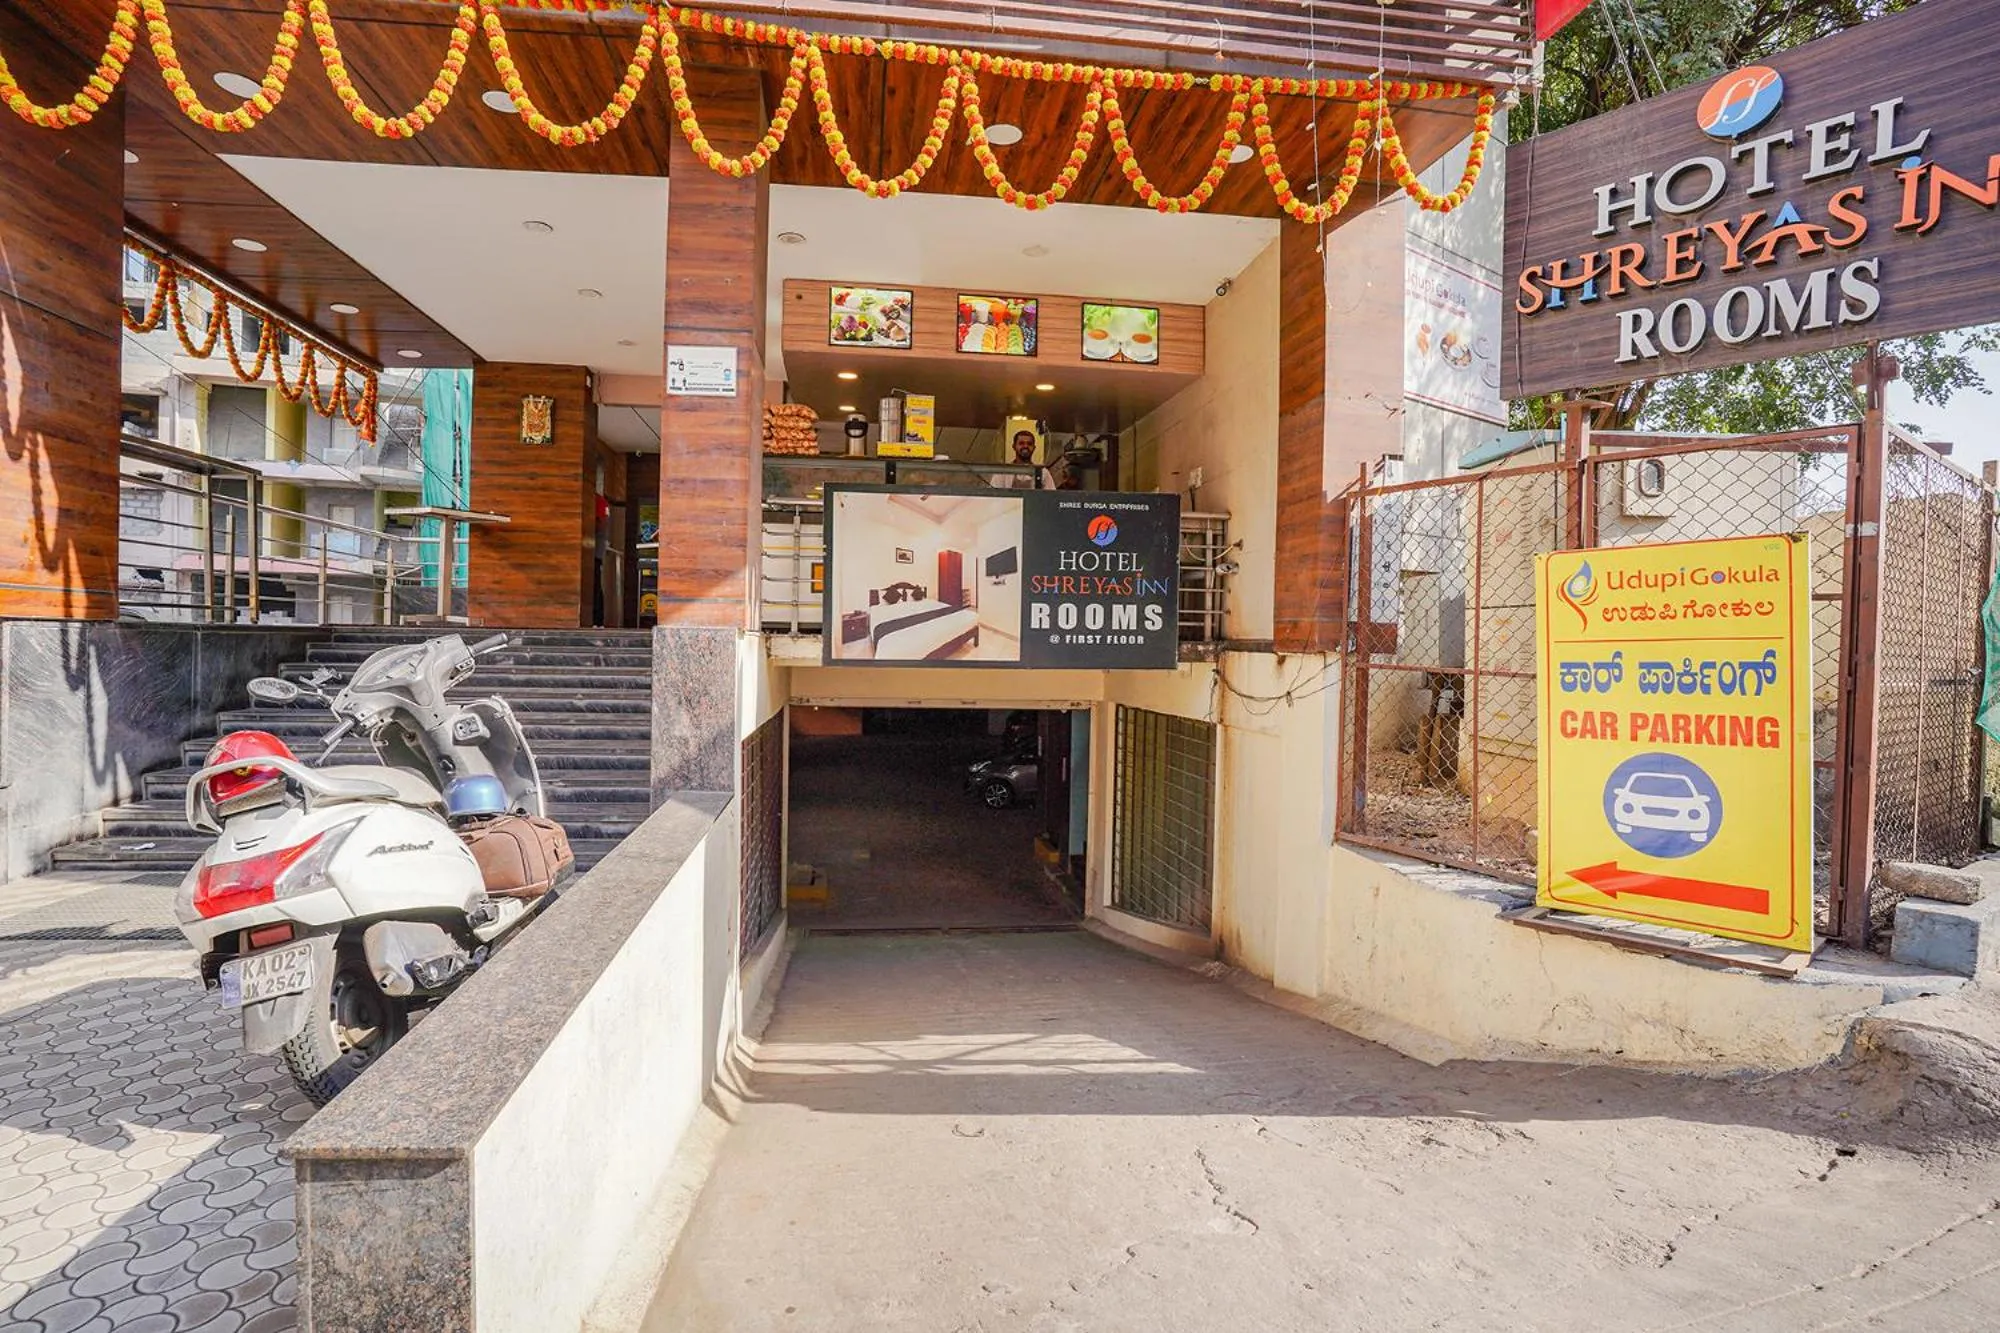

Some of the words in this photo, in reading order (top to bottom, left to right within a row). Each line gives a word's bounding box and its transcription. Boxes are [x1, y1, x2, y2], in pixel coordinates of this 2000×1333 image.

[1592, 96, 1932, 237] HOTEL
[1516, 185, 1868, 315] SHREYAS
[1892, 154, 2000, 233] IN
[1614, 257, 1881, 364] ROOMS
[1059, 551, 1144, 572] HOTEL
[1030, 575, 1133, 596] SHREYAS
[1030, 602, 1163, 631] ROOMS
[1065, 634, 1101, 645] FIRST
[1107, 635, 1145, 645] FLOOR
[1559, 649, 1623, 694] ಕಾರ್
[1637, 648, 1777, 697] ಪಾರ್ಕಿಂಗ್
[1559, 709, 1619, 741] CAR
[1630, 712, 1781, 749] PARKING
[265, 970, 306, 994] 2547
